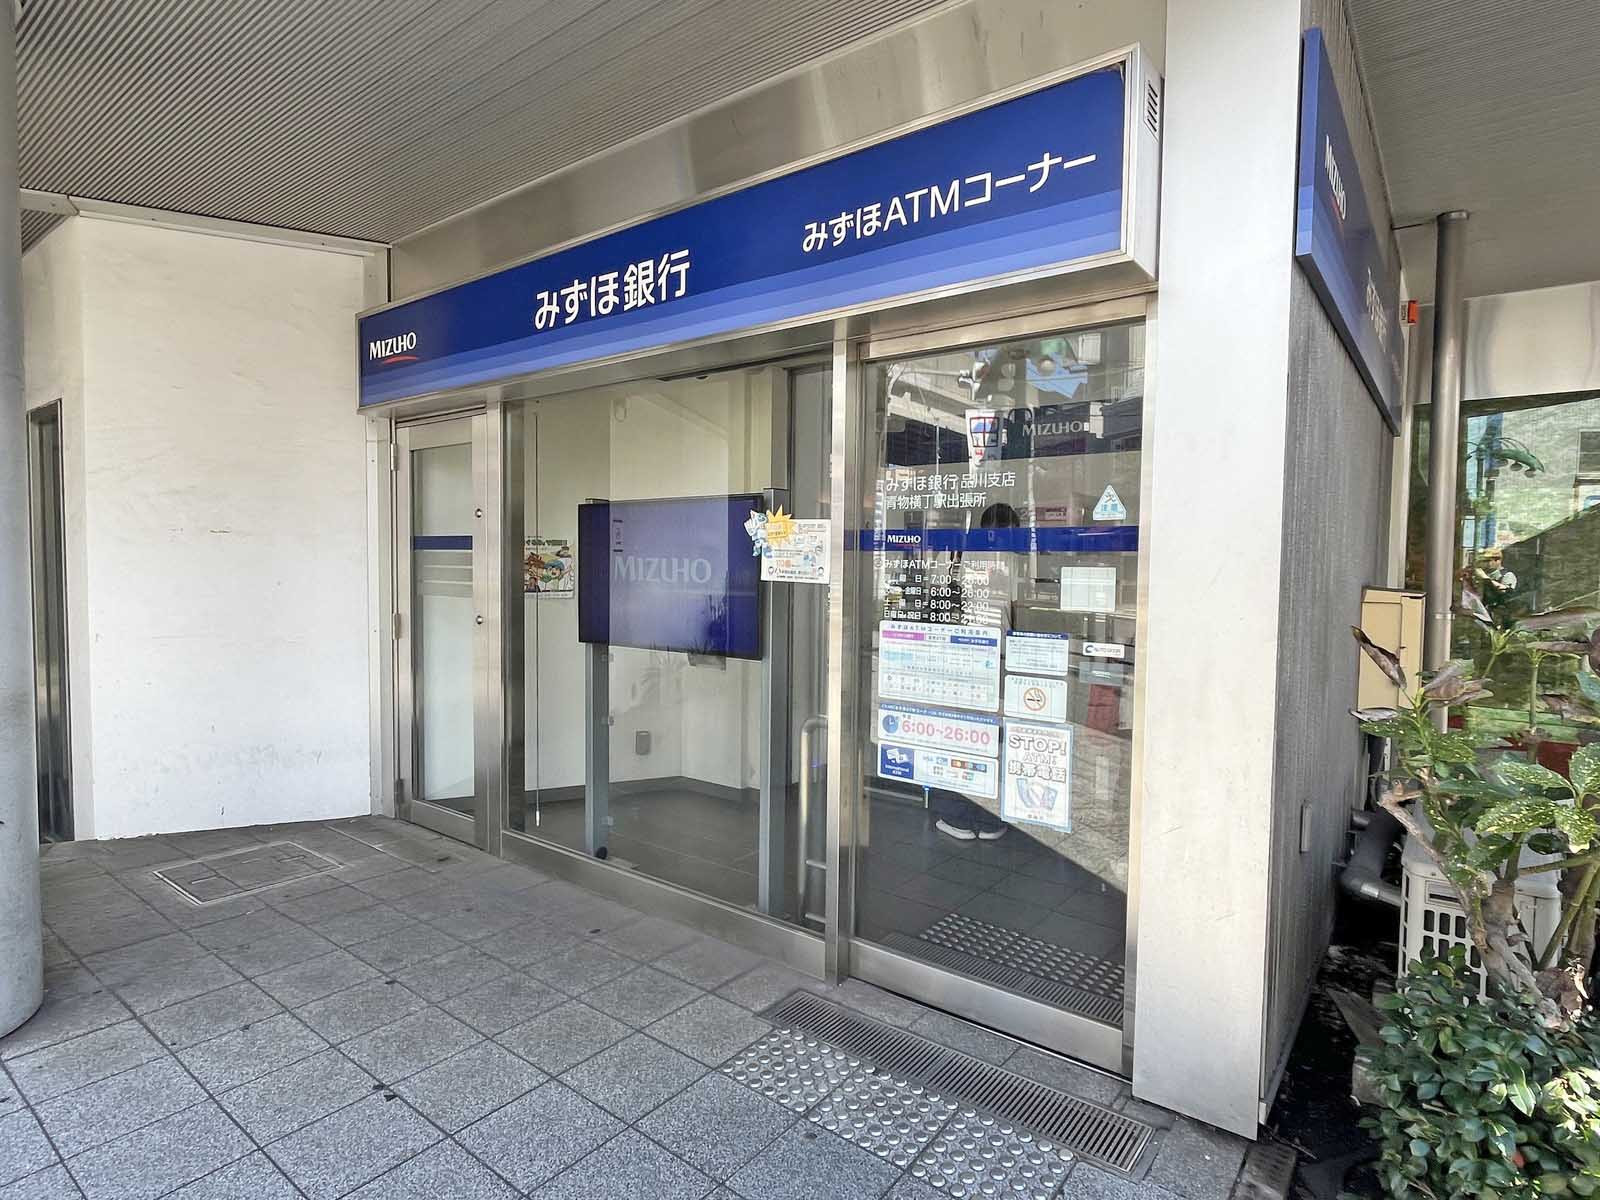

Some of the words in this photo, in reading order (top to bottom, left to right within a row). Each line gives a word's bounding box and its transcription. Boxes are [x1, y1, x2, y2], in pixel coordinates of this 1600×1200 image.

[1325, 134, 1347, 221] MIZUHO
[802, 152, 1097, 253] みずほATMコーナー
[534, 249, 690, 330] みずほ銀行
[369, 331, 417, 361] MIZUHO
[1022, 421, 1084, 438] MIZUHO
[886, 473, 957, 491] みずほ銀行
[960, 472, 1016, 488] 品川支店
[886, 534, 922, 544] MIZUHO
[613, 554, 712, 584] MIZUHO
[1008, 735, 1067, 756] STOP!
